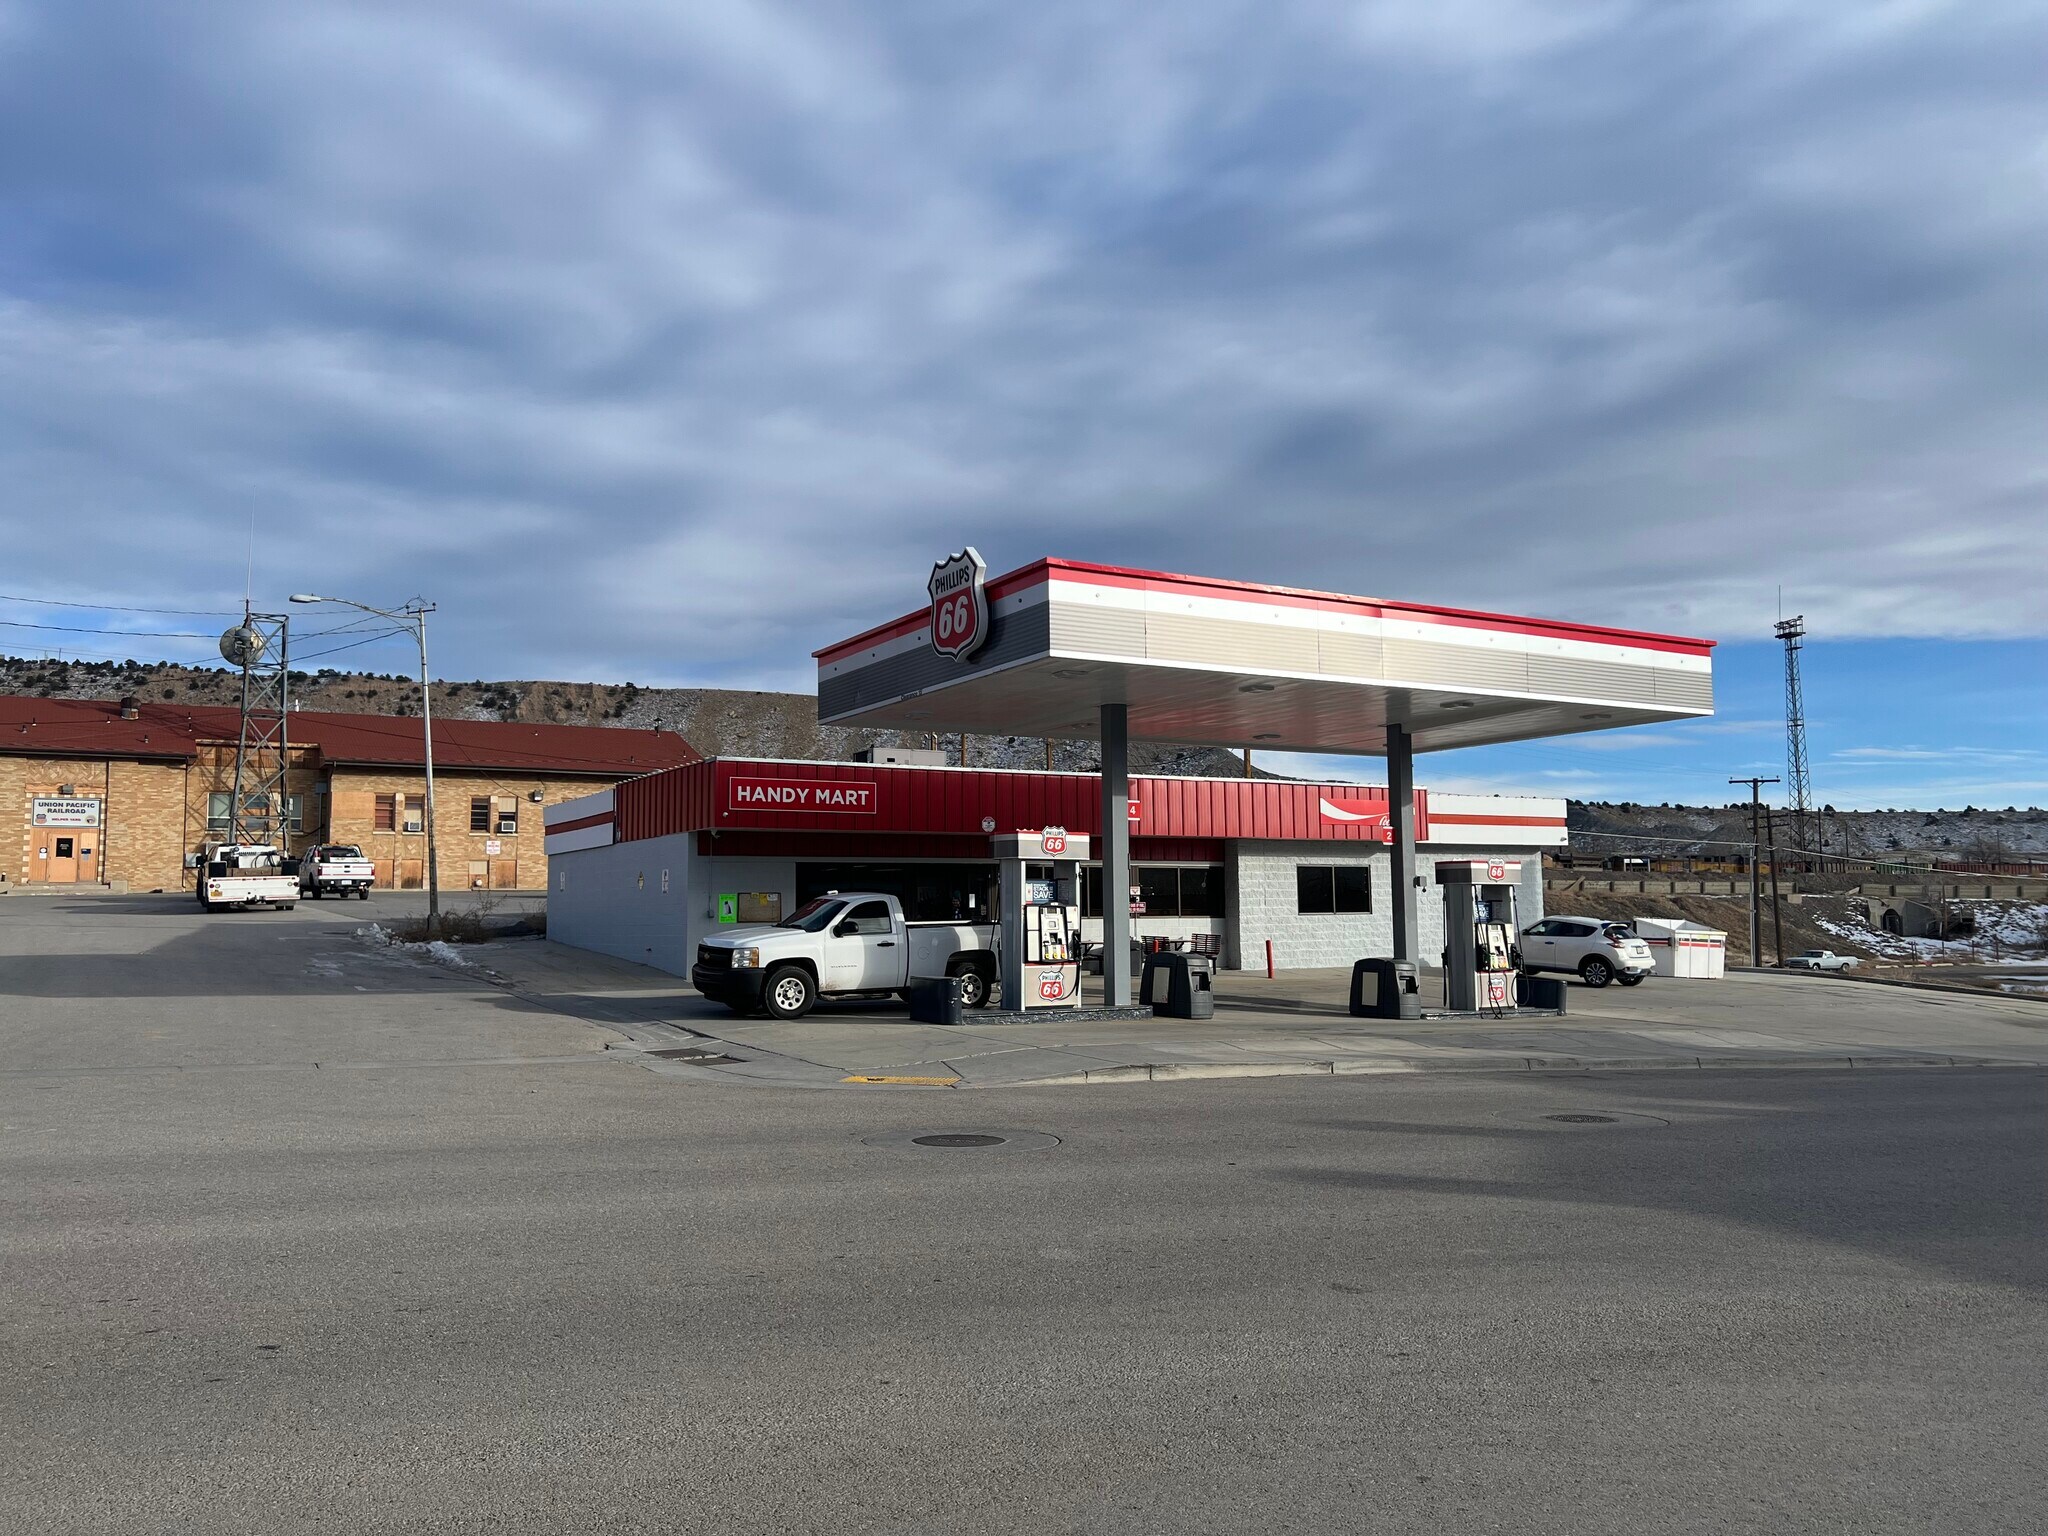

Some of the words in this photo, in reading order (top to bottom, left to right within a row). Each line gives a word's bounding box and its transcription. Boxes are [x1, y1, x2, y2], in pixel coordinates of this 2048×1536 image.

[935, 565, 970, 595] PHILLIPS
[939, 595, 968, 640] 66
[737, 785, 809, 803] HANDY
[815, 789, 869, 806] MART
[1129, 806, 1136, 815] 4
[1386, 832, 1392, 840] 2
[1046, 838, 1063, 850] 66
[1491, 867, 1503, 877] 66
[1033, 891, 1054, 899] SAVE
[1043, 983, 1060, 996] 66
